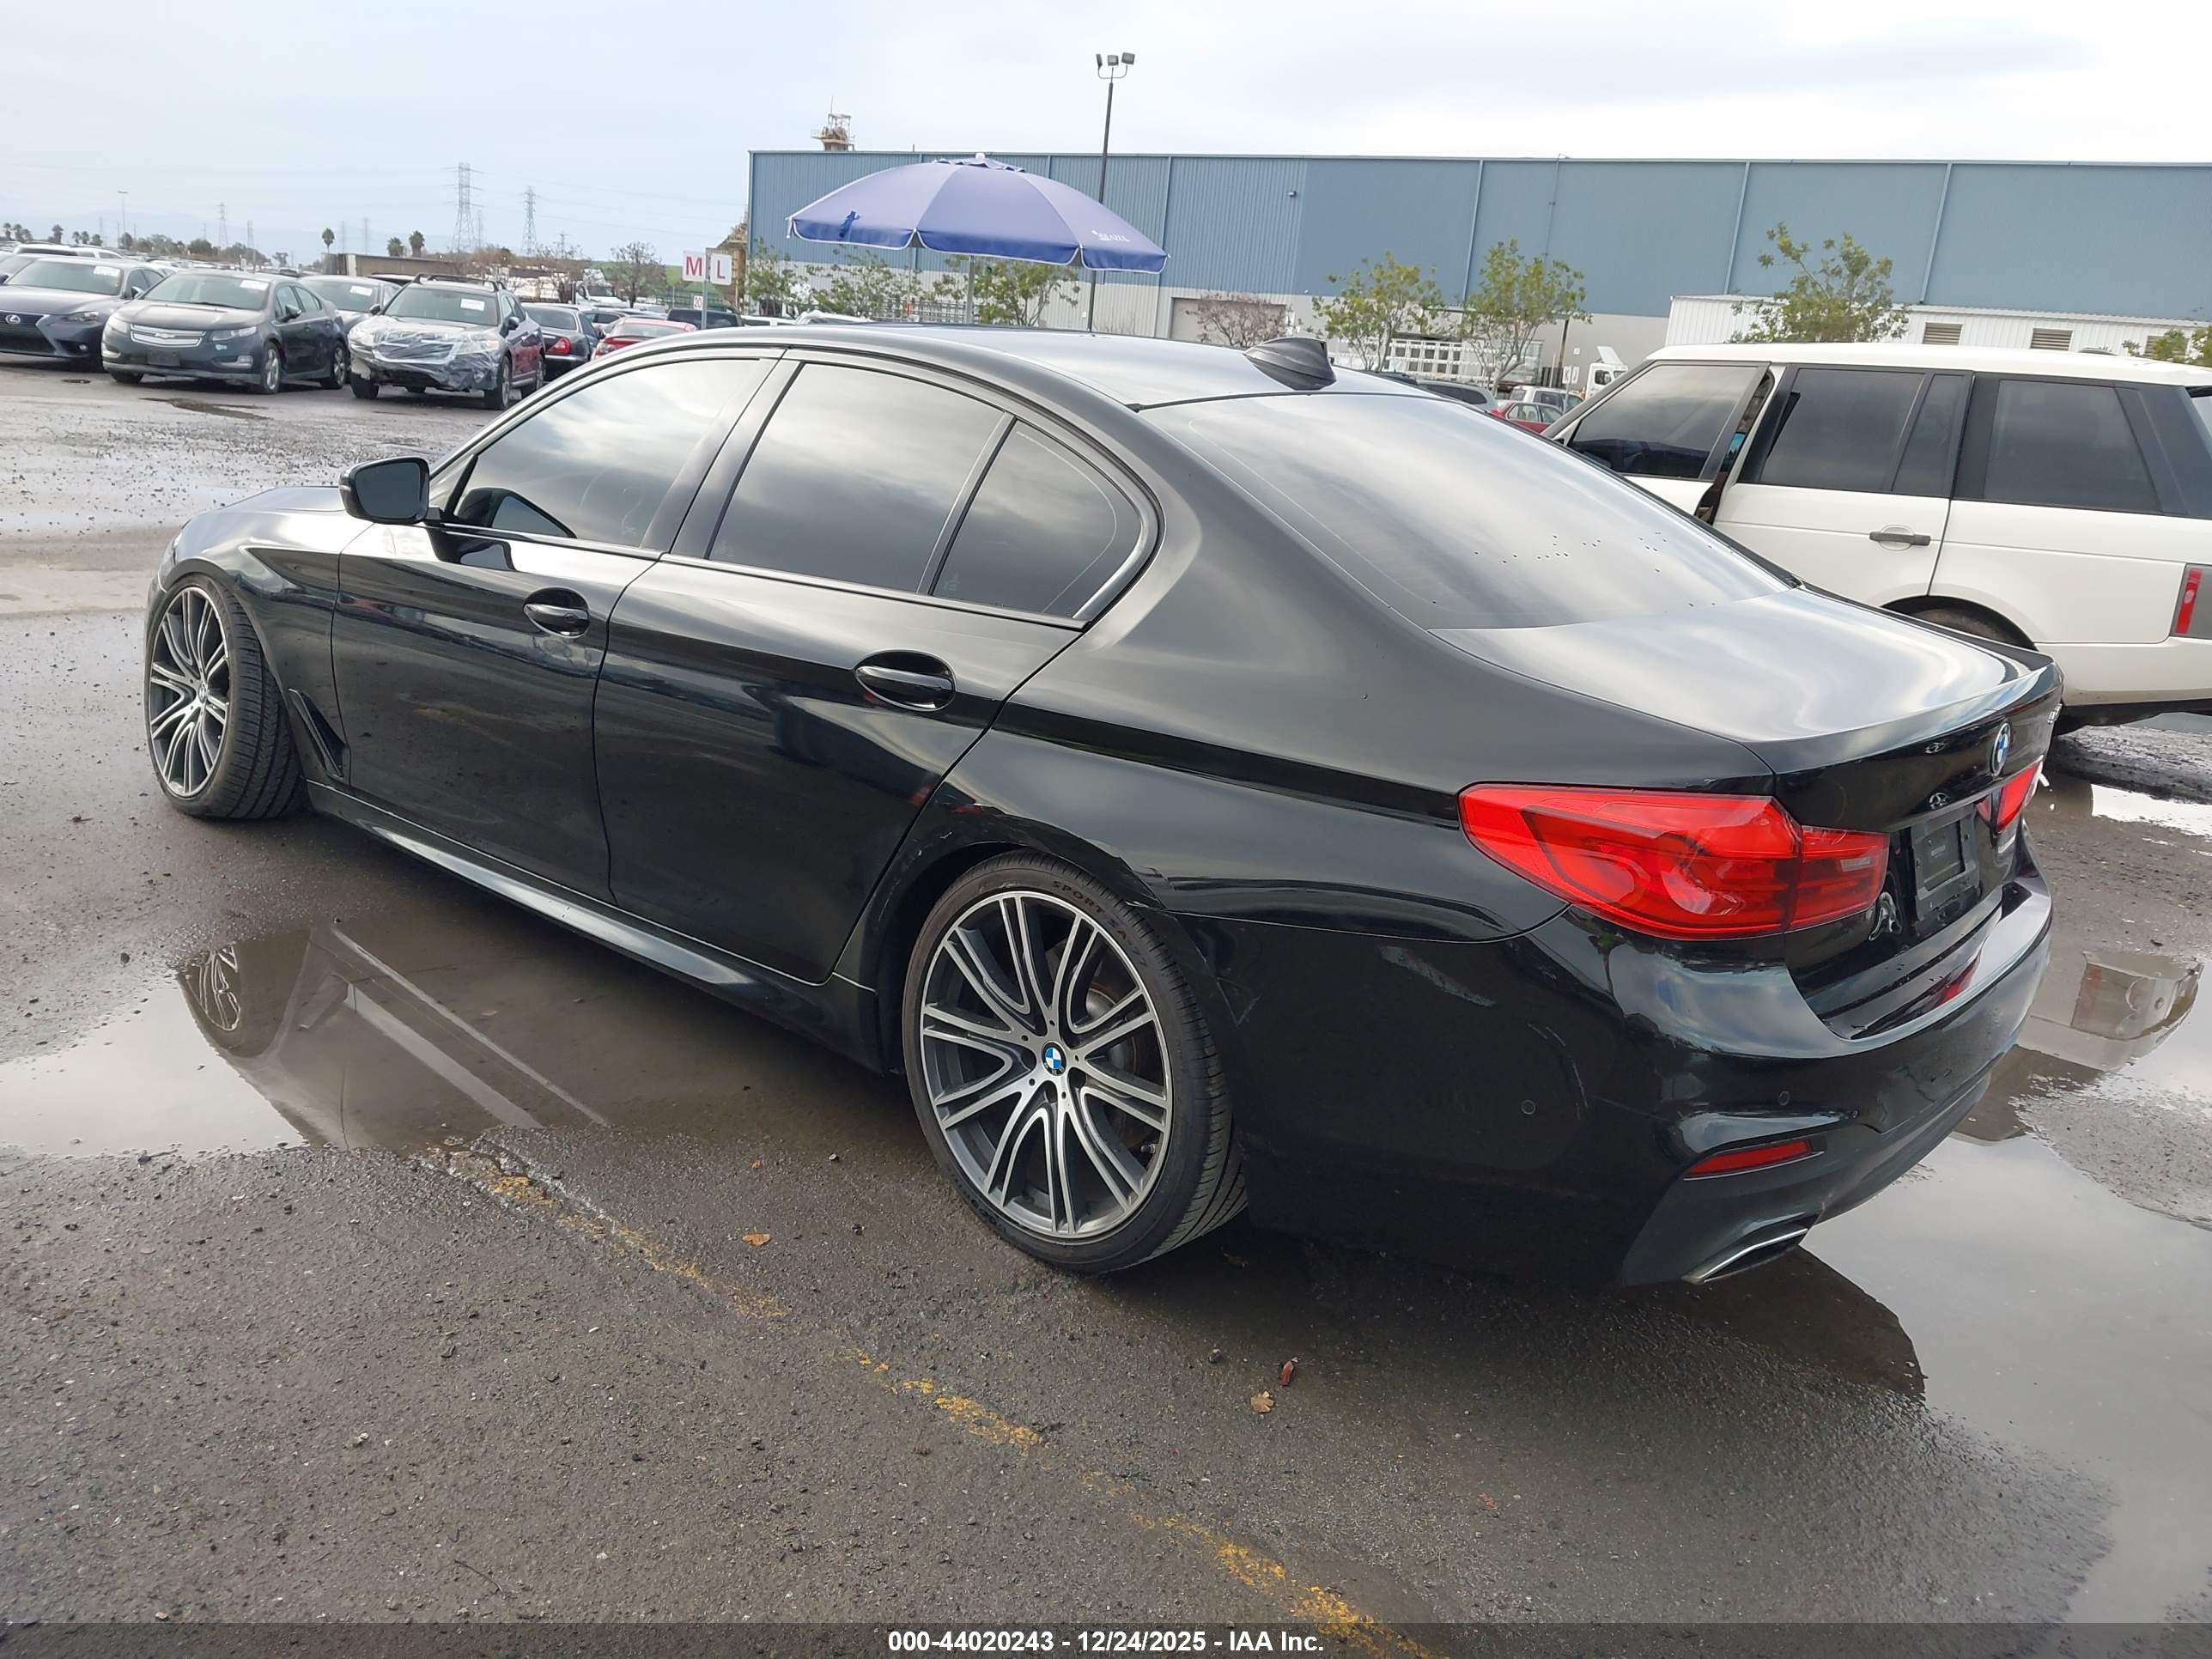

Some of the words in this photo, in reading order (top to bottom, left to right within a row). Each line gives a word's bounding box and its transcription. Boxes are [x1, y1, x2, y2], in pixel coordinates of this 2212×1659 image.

[686, 256, 702, 276] M
[717, 260, 726, 280] L
[694, 296, 702, 308] 20
[1051, 880, 1105, 914] SPORT
